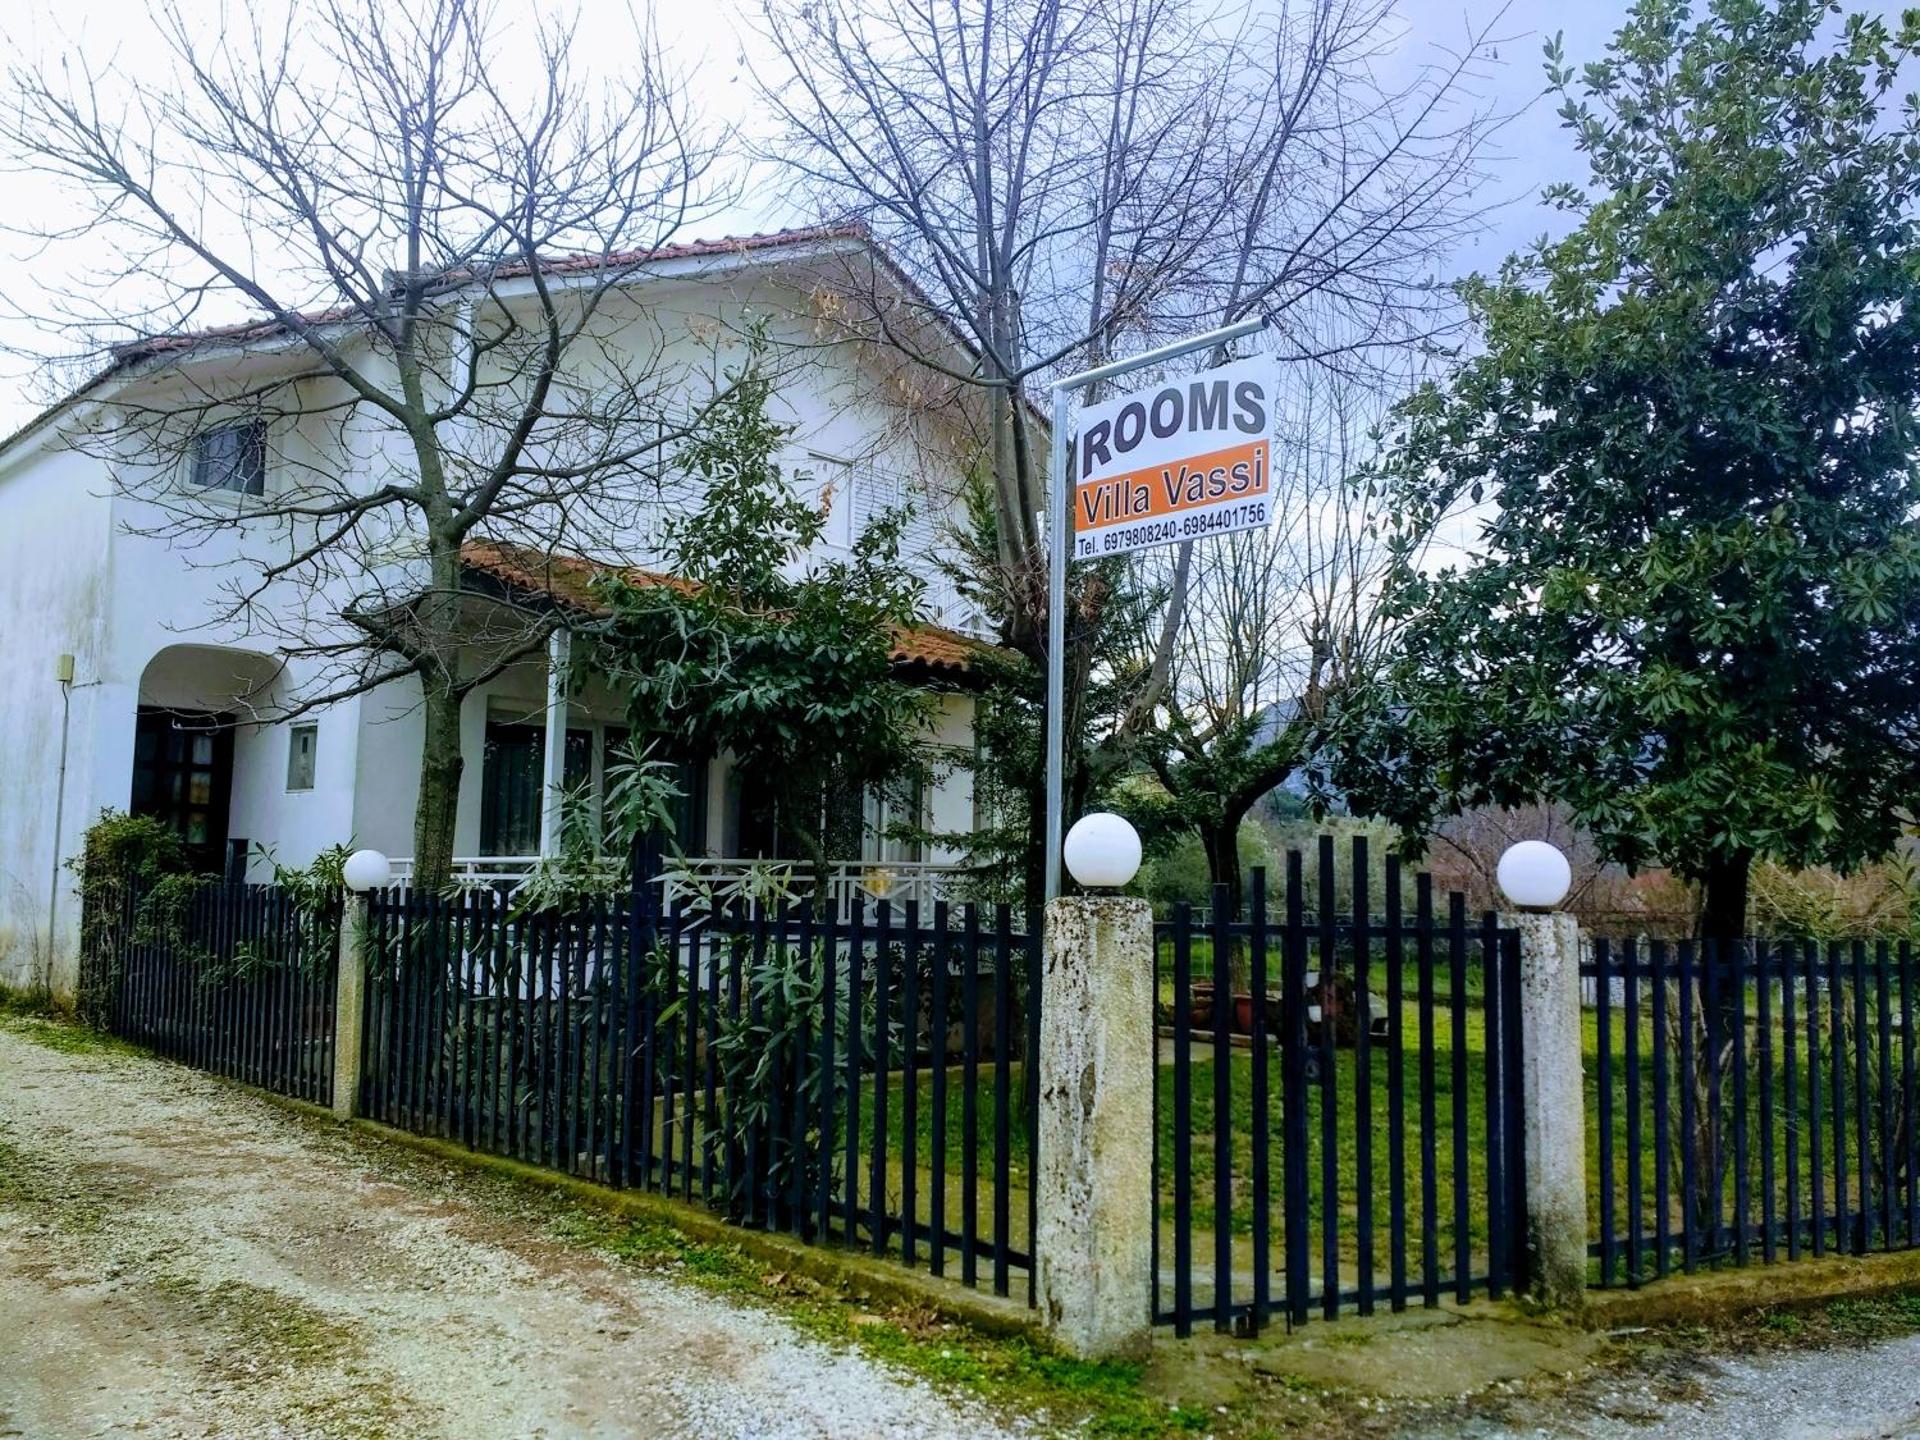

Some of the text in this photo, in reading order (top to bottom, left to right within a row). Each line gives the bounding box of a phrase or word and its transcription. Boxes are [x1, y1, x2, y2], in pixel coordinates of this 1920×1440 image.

[1082, 380, 1266, 479] ROOMS
[1081, 448, 1263, 525] Villa Vassi
[1078, 537, 1099, 556] Tel.
